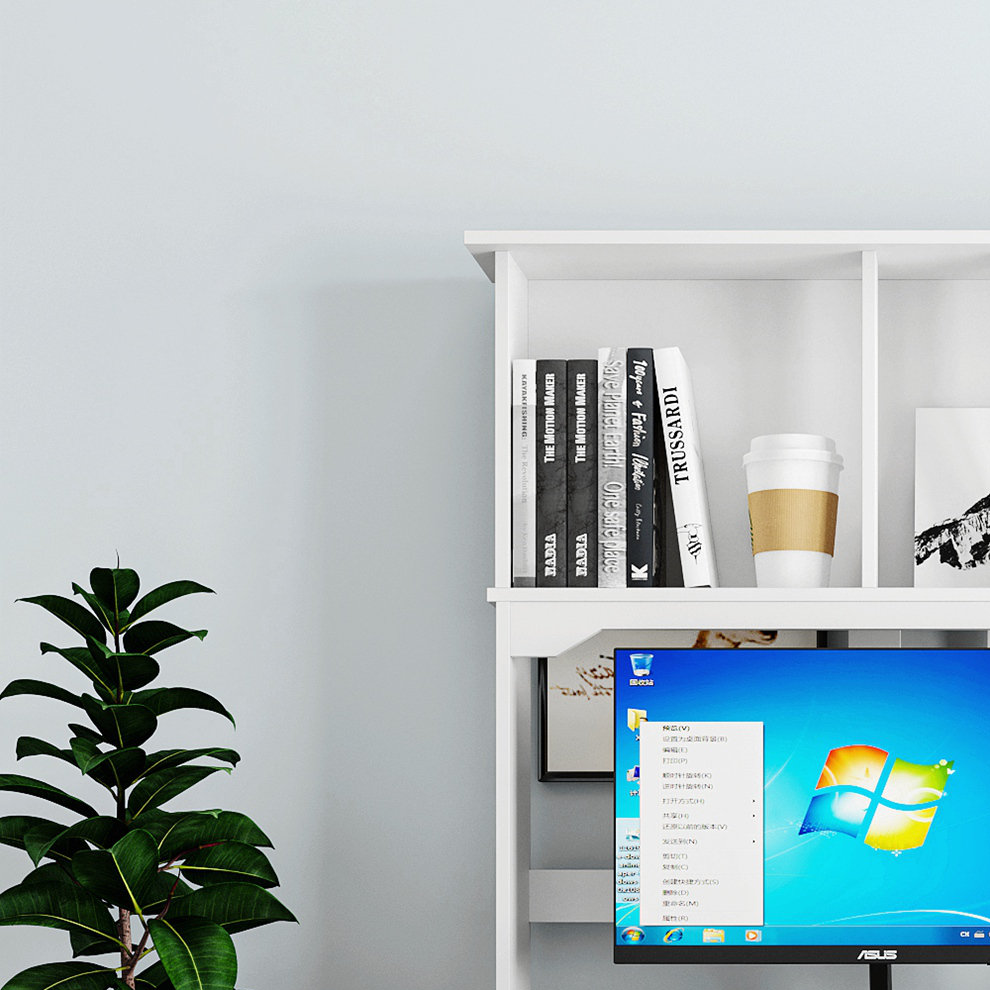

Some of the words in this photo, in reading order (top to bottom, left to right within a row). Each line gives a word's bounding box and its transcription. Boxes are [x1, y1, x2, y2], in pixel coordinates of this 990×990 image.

[543, 373, 555, 406] MAKER
[575, 373, 586, 406] MAKER
[602, 359, 622, 390] Save
[543, 407, 555, 444] MOTION
[575, 407, 586, 444] MOTION
[602, 393, 623, 430] Planet
[631, 412, 647, 447] Fashion
[662, 386, 690, 486] TRUSSARDI
[543, 444, 555, 464] THE
[575, 444, 586, 464] THE
[602, 433, 626, 469] Earth!
[602, 481, 623, 509] One
[602, 511, 626, 541] safe
[599, 540, 626, 573] place
[857, 950, 898, 960] ASUS
